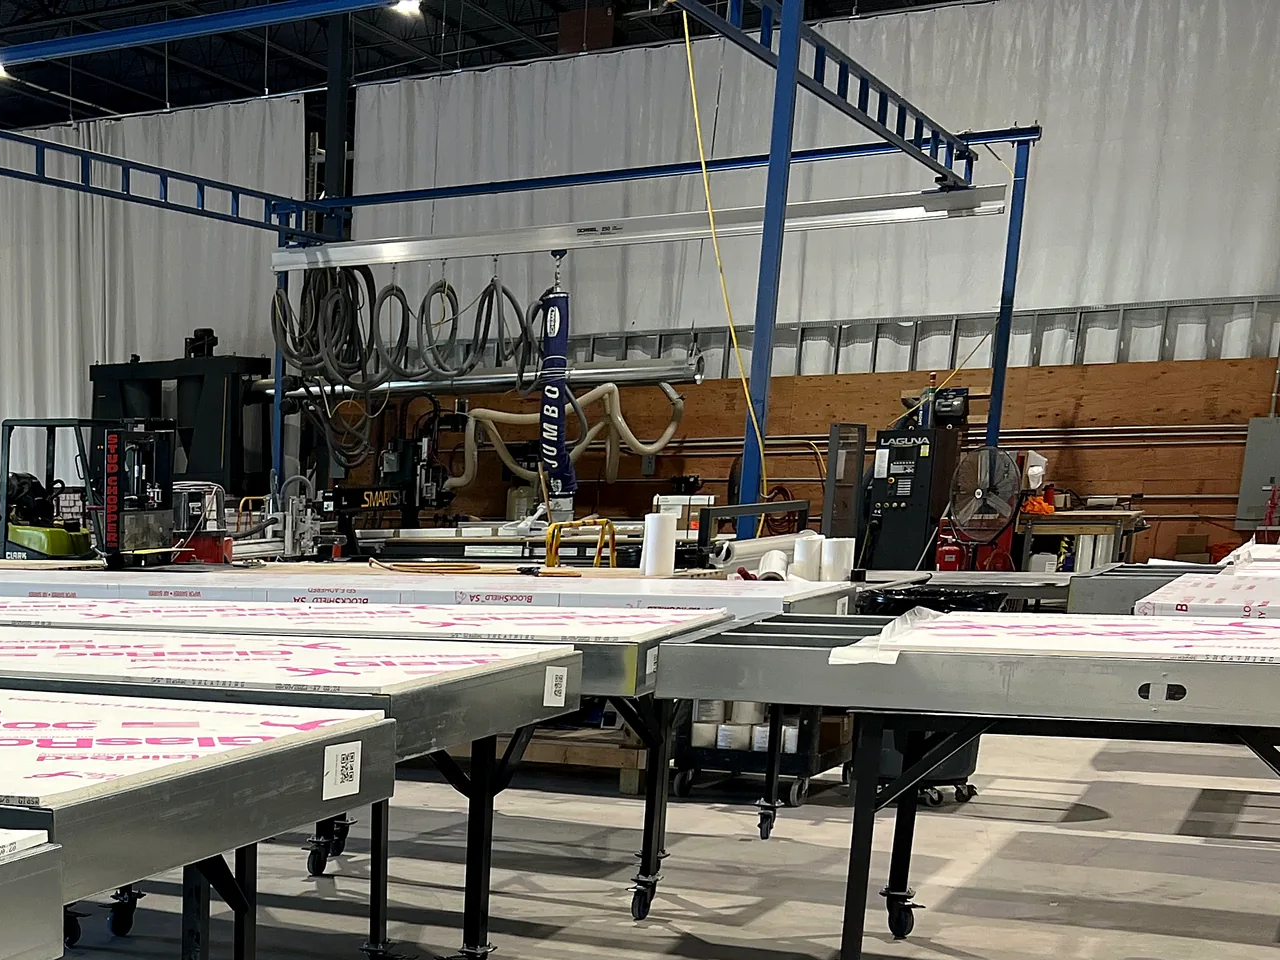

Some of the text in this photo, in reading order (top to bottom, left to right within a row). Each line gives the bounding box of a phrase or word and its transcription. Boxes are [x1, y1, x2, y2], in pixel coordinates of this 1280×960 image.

[543, 385, 560, 468] JUMBO
[881, 436, 930, 446] LAGUNA
[107, 434, 118, 473] STUD
[107, 477, 118, 542] CHOPPER
[5, 551, 27, 560] CLARK
[1205, 654, 1275, 662] SHEATHING
